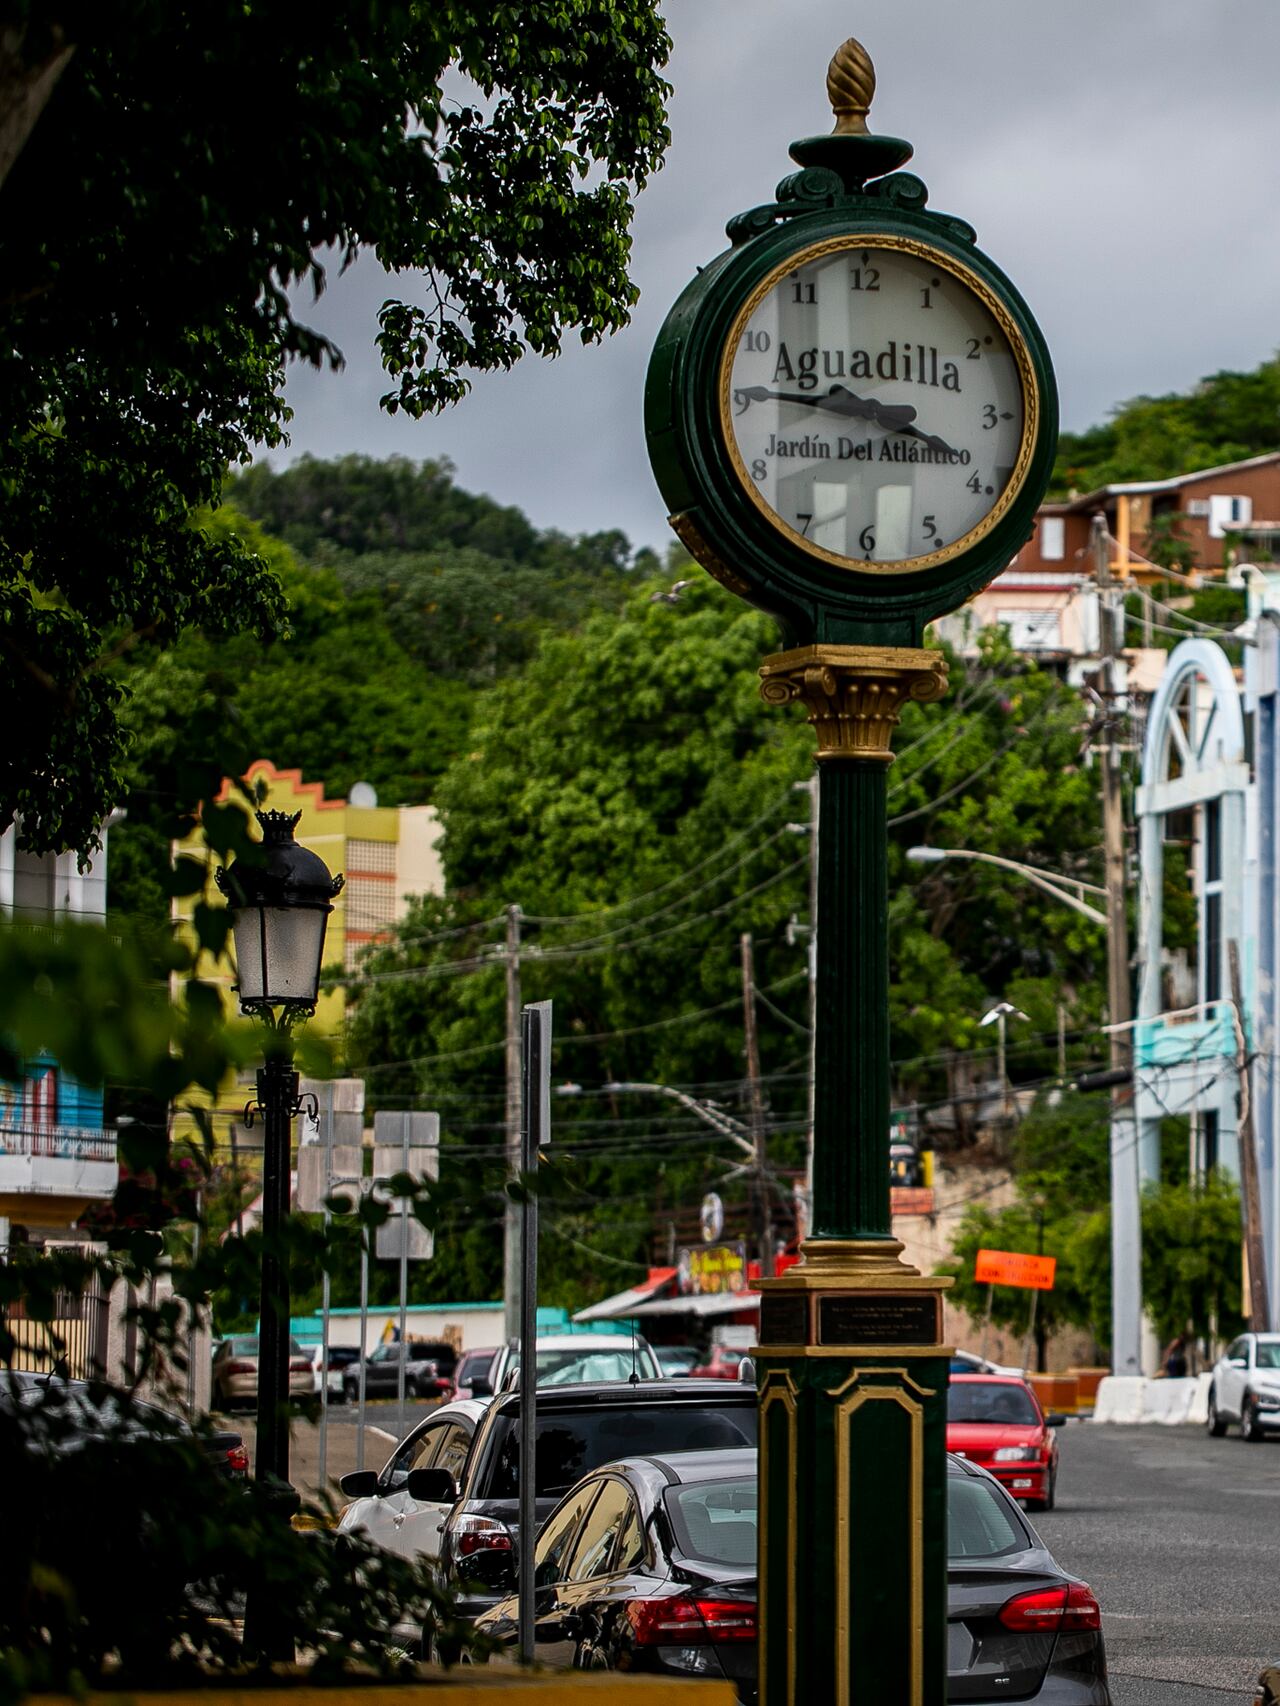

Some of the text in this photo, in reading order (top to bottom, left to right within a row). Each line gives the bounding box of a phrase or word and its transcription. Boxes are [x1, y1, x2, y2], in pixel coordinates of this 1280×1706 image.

[850, 268, 880, 292] 12
[792, 282, 819, 305] 11
[920, 287, 933, 309] 1
[744, 330, 771, 353] 10
[966, 338, 981, 360] 2
[772, 341, 962, 393] Aguadilla
[734, 389, 751, 416] 9
[982, 404, 998, 430] 3
[765, 434, 831, 459] Jardín
[838, 437, 873, 461] Del
[752, 460, 768, 481] 8
[966, 470, 982, 494] 4
[796, 513, 812, 537] 7
[922, 515, 936, 540] 5
[859, 525, 876, 551] 6
